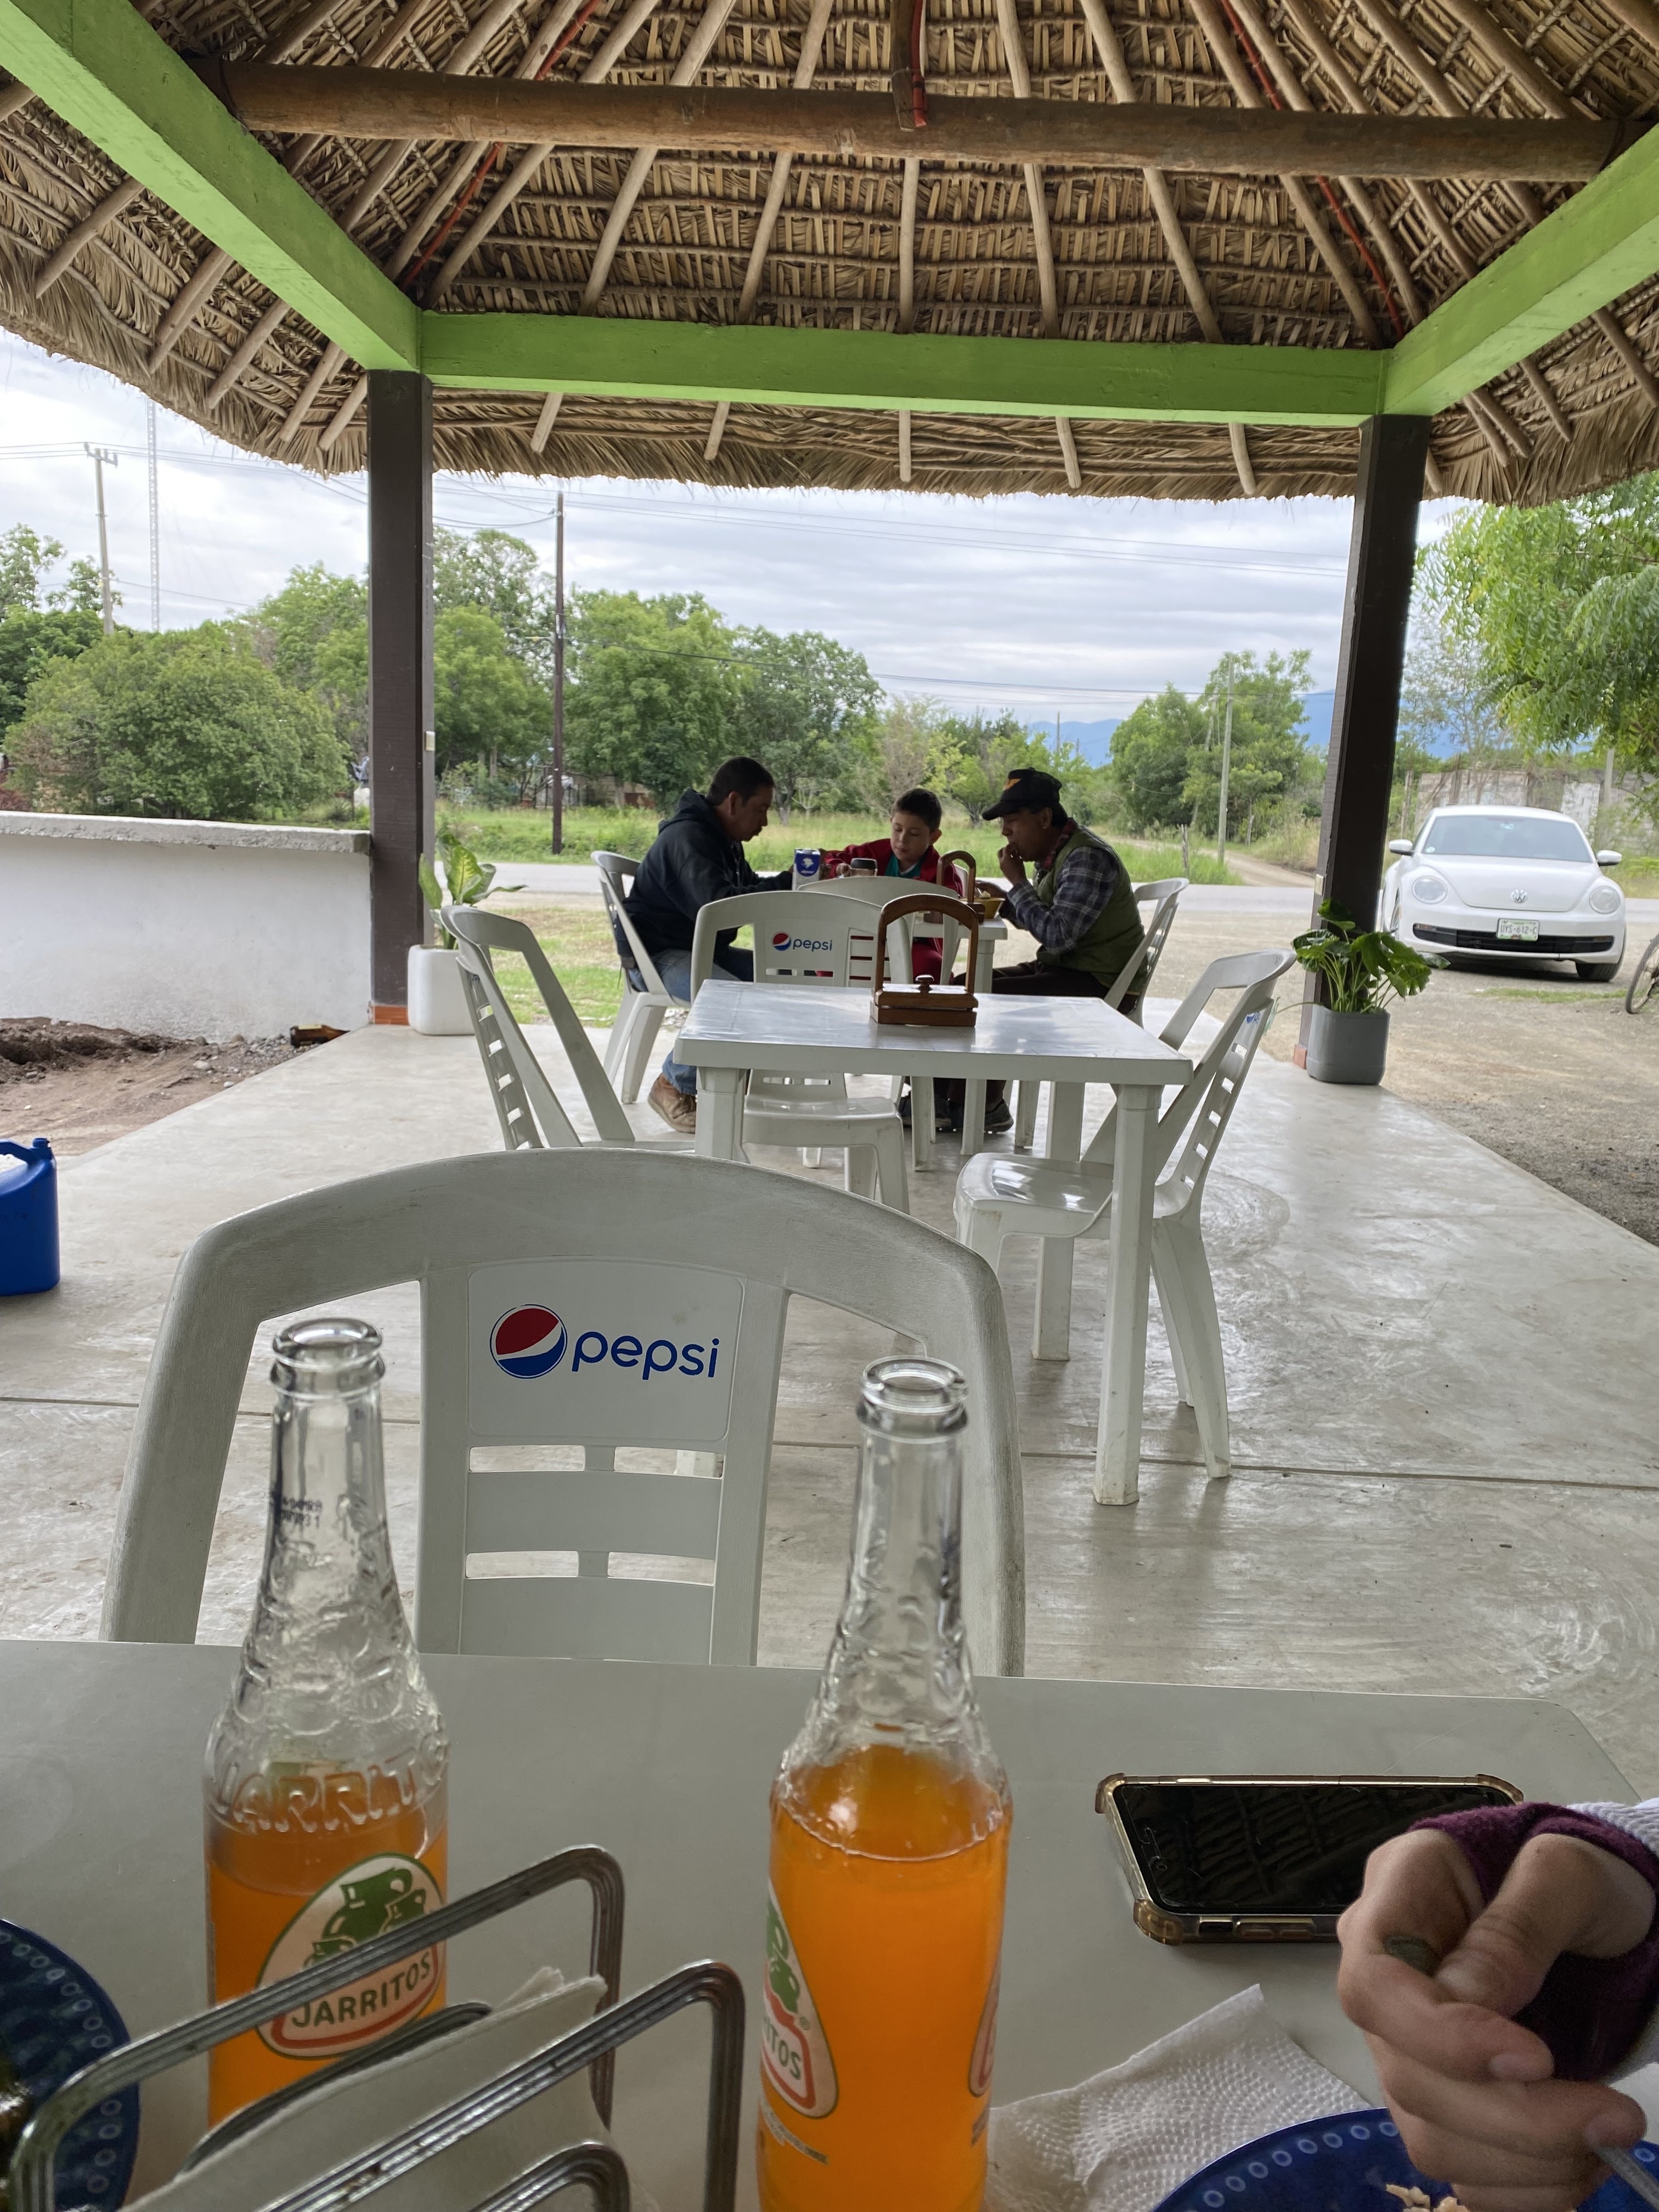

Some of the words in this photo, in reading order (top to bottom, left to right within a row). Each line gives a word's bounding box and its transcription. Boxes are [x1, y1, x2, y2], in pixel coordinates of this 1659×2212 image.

[1500, 924, 1537, 935] UYS-612-C
[793, 939, 833, 952] pepsi
[572, 1331, 720, 1380] pepsi
[291, 1951, 431, 2028] JARRITOS
